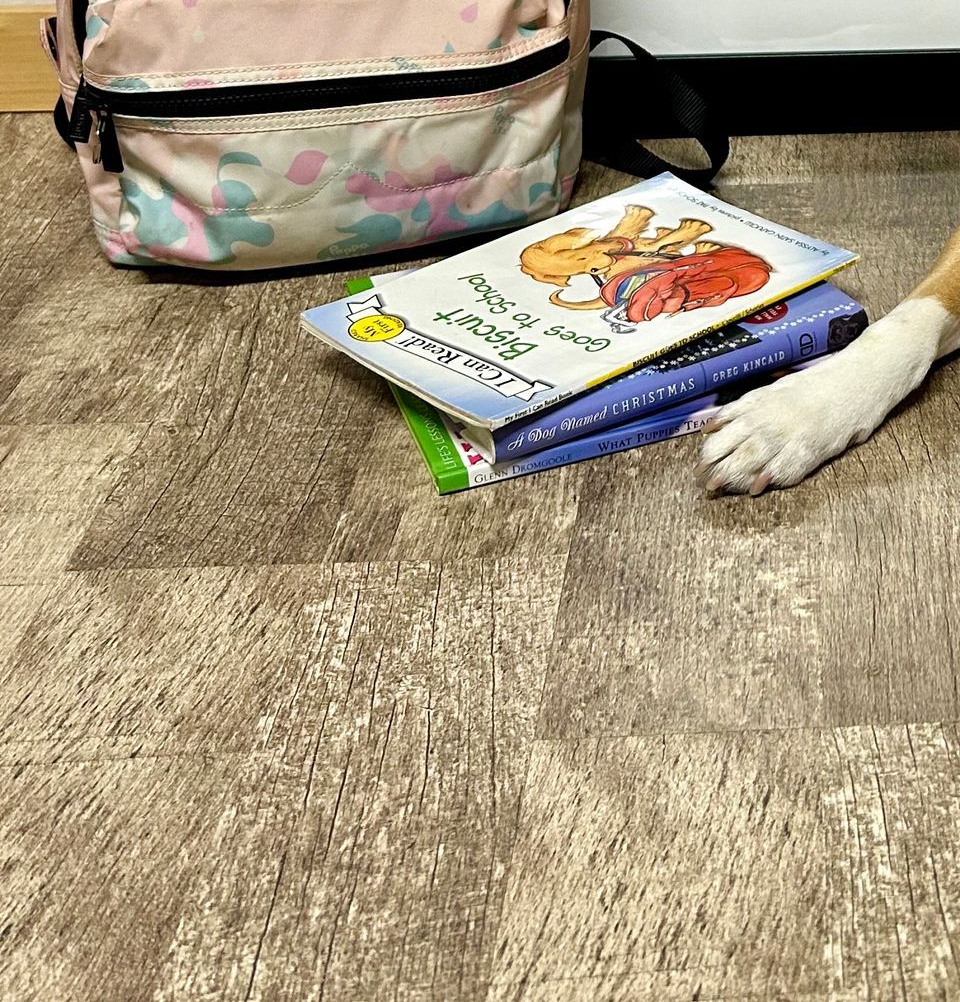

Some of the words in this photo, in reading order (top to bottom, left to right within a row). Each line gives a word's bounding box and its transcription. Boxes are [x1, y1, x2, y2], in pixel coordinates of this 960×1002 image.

[457, 273, 516, 314] School
[433, 308, 539, 361] Biscuit
[512, 313, 541, 329] to
[688, 325, 714, 341] SCHOOL
[398, 335, 463, 365] Read!
[544, 325, 612, 353] Goes
[463, 358, 503, 380] Can
[712, 366, 739, 383] GREG
[743, 350, 785, 372] KINCAID
[496, 377, 517, 387] I
[507, 429, 525, 451] A
[528, 425, 557, 443] Dog
[560, 405, 608, 431] Named
[612, 378, 696, 416] CHRISTMAS
[597, 436, 634, 453] WHAT
[636, 425, 681, 444] PUPPIES
[474, 470, 509, 484] GLENN
[512, 452, 573, 475] DROMGOOLE
